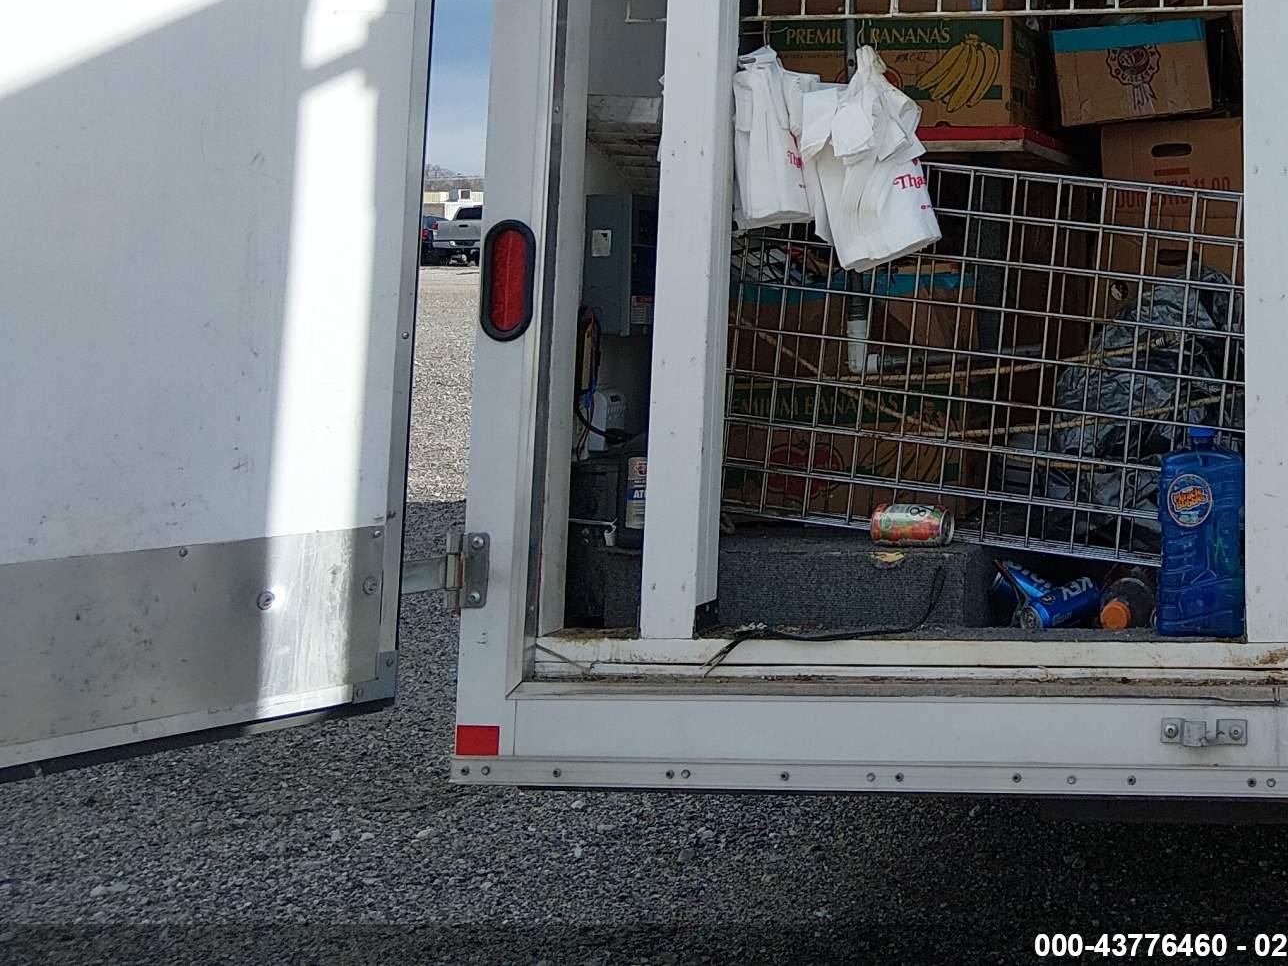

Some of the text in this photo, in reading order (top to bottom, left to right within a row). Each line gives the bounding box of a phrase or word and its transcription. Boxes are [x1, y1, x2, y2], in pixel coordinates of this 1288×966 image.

[786, 26, 951, 44] PREMIU BANANAS
[803, 393, 898, 416] BANAS
